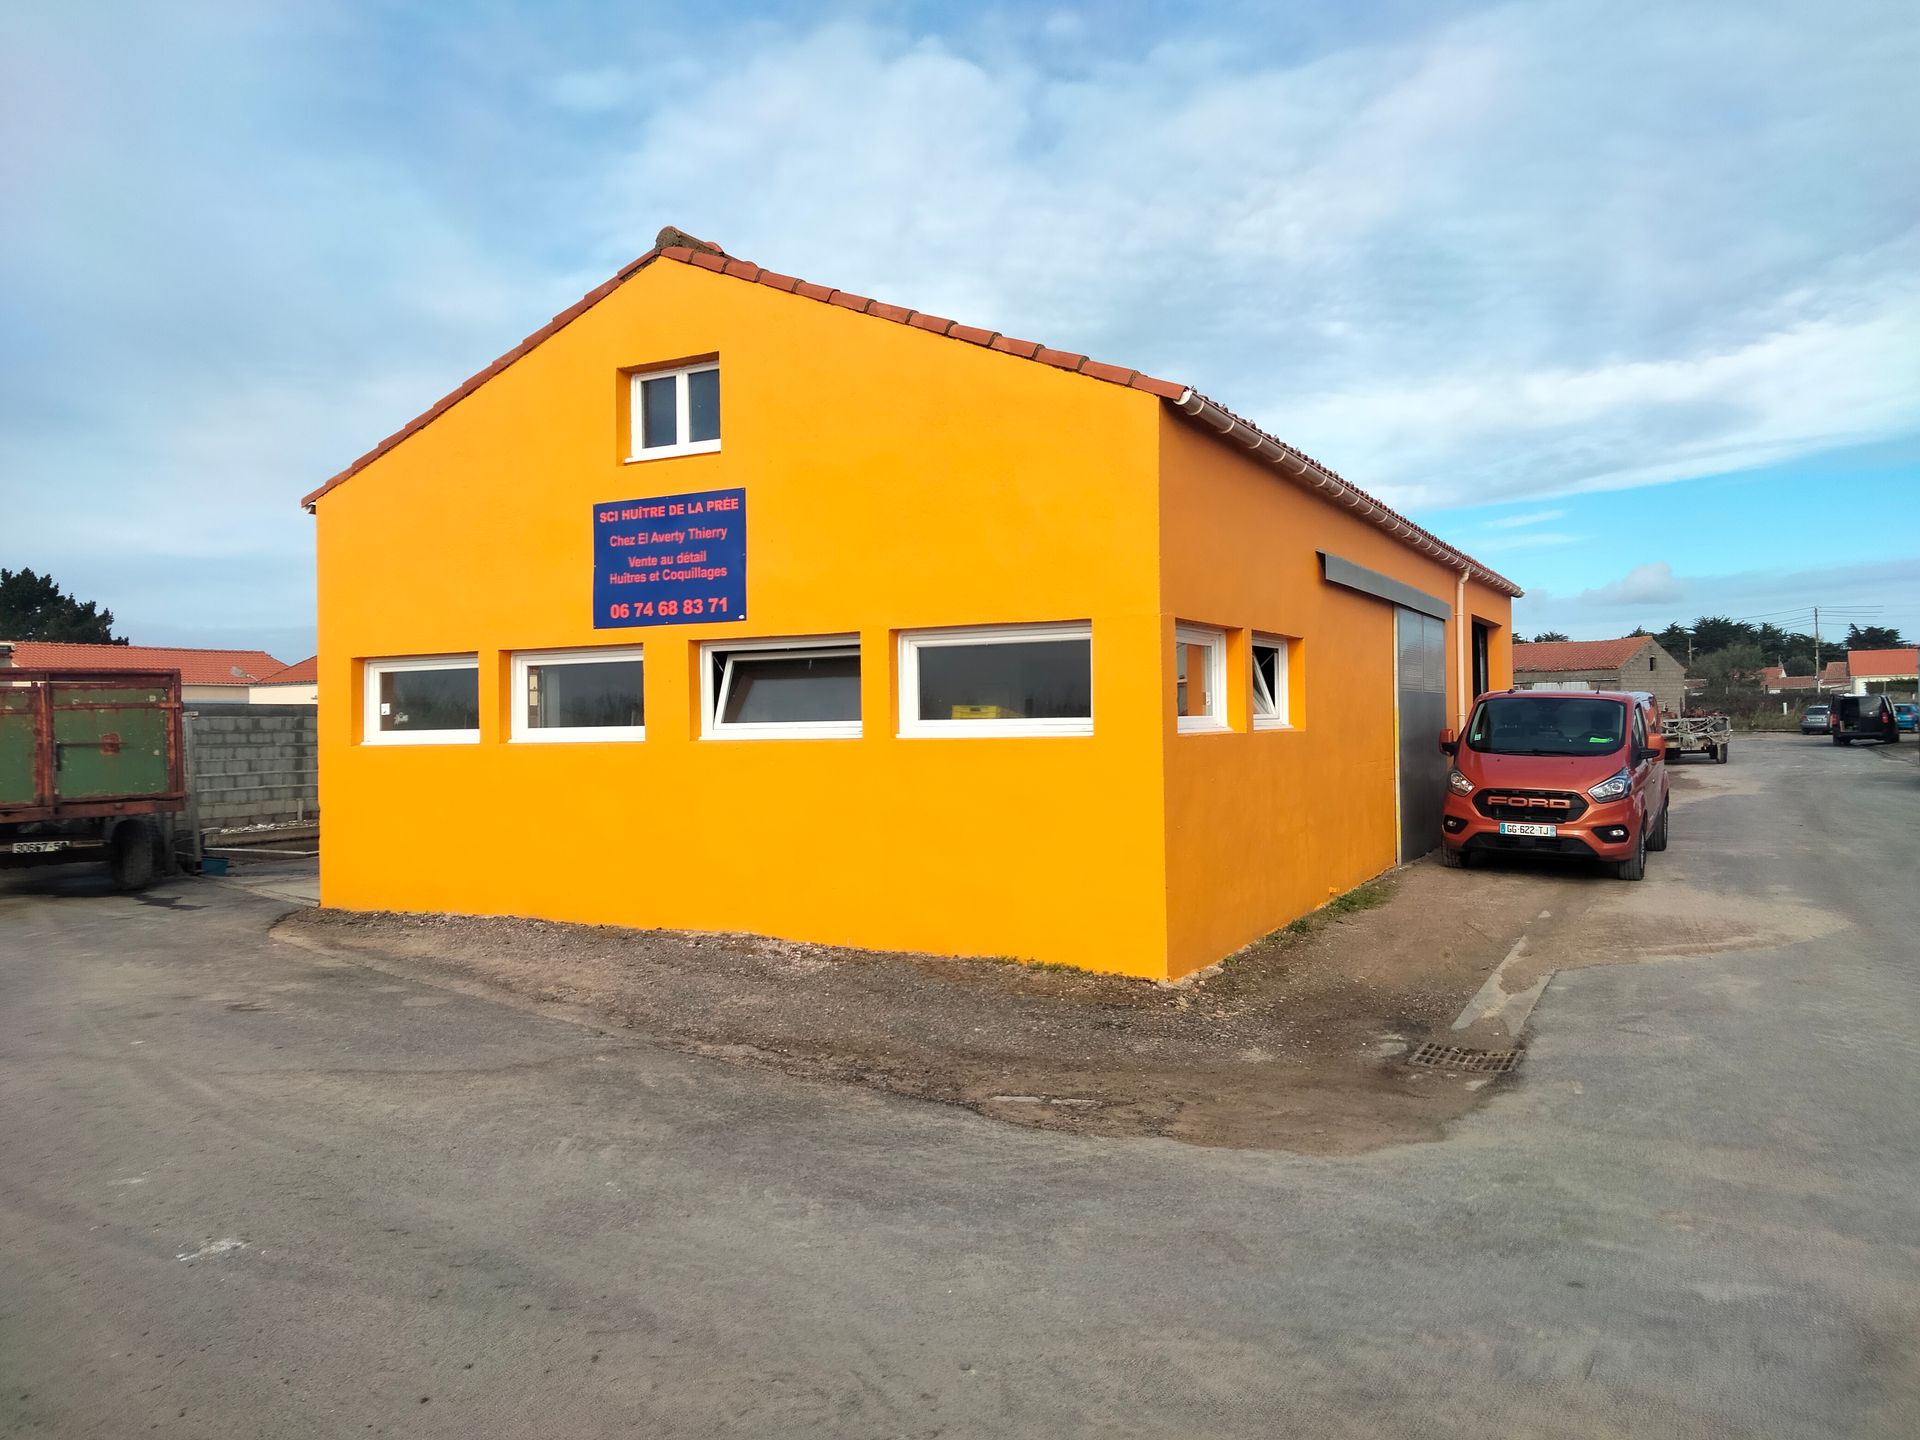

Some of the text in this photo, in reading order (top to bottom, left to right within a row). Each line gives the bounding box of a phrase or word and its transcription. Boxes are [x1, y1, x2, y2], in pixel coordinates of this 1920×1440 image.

[600, 496, 739, 523] SCI HUÎTRE DE LA PRÉE
[609, 534, 635, 547] Chez
[651, 529, 685, 544] Averty
[688, 526, 727, 540] Thierry
[628, 550, 706, 567] Vente au détail
[609, 566, 727, 584] Huîtres et Coquillages
[610, 597, 728, 619] 06 74 68 83 71
[1487, 796, 1570, 809] FORD
